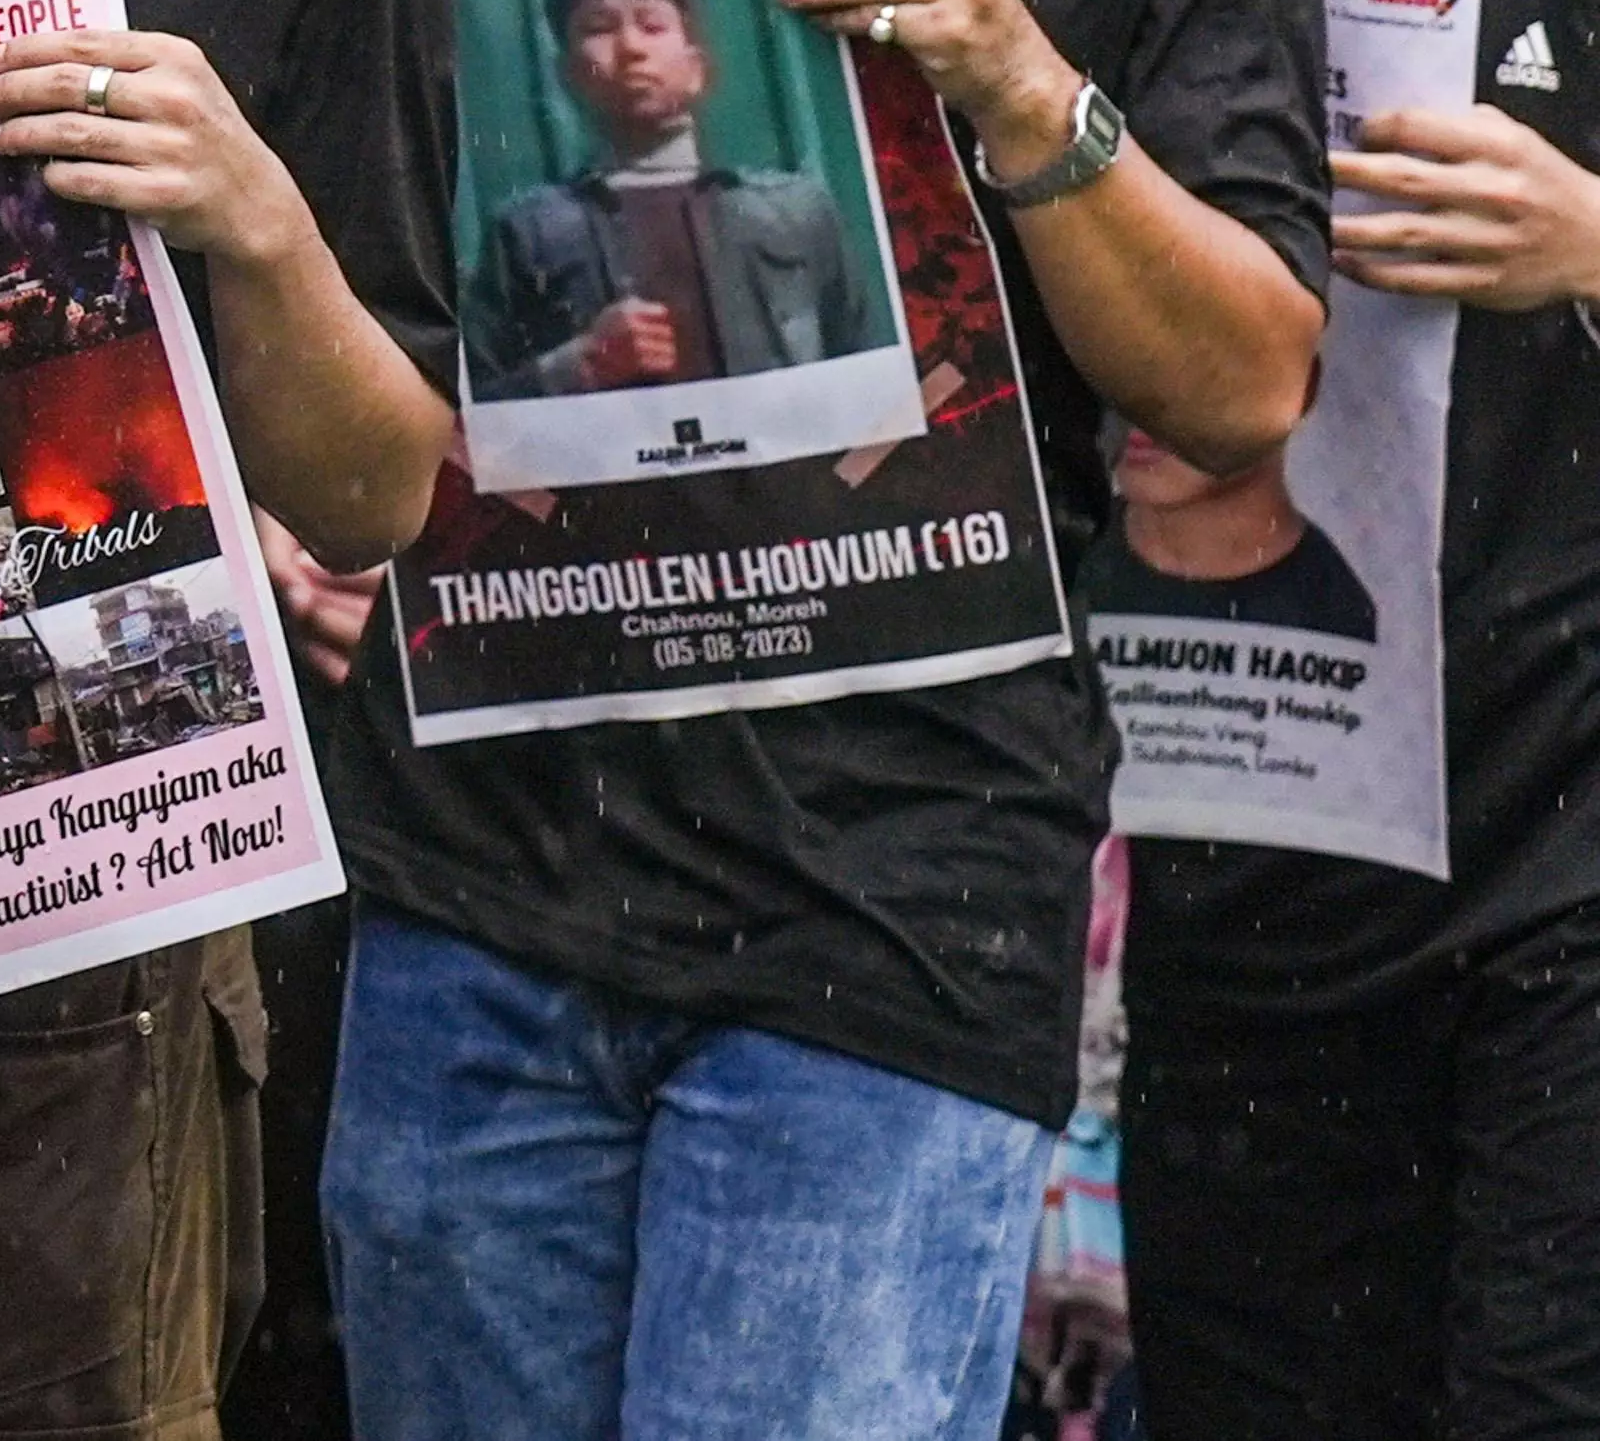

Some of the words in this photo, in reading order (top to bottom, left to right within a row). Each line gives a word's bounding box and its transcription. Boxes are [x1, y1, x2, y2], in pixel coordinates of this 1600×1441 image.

[429, 552, 715, 627] THANGGOULEN
[718, 526, 916, 600] LHOUVUM
[920, 511, 1010, 571] (16)
[747, 597, 828, 624] Moreh
[653, 625, 814, 670] (05-08-2023)
[1096, 634, 1235, 674] ALMUON
[1250, 645, 1367, 691] HAOKIP
[49, 766, 221, 839] Kangujam
[227, 745, 286, 789] aka
[137, 835, 195, 888] Act
[201, 805, 284, 864] Now!
